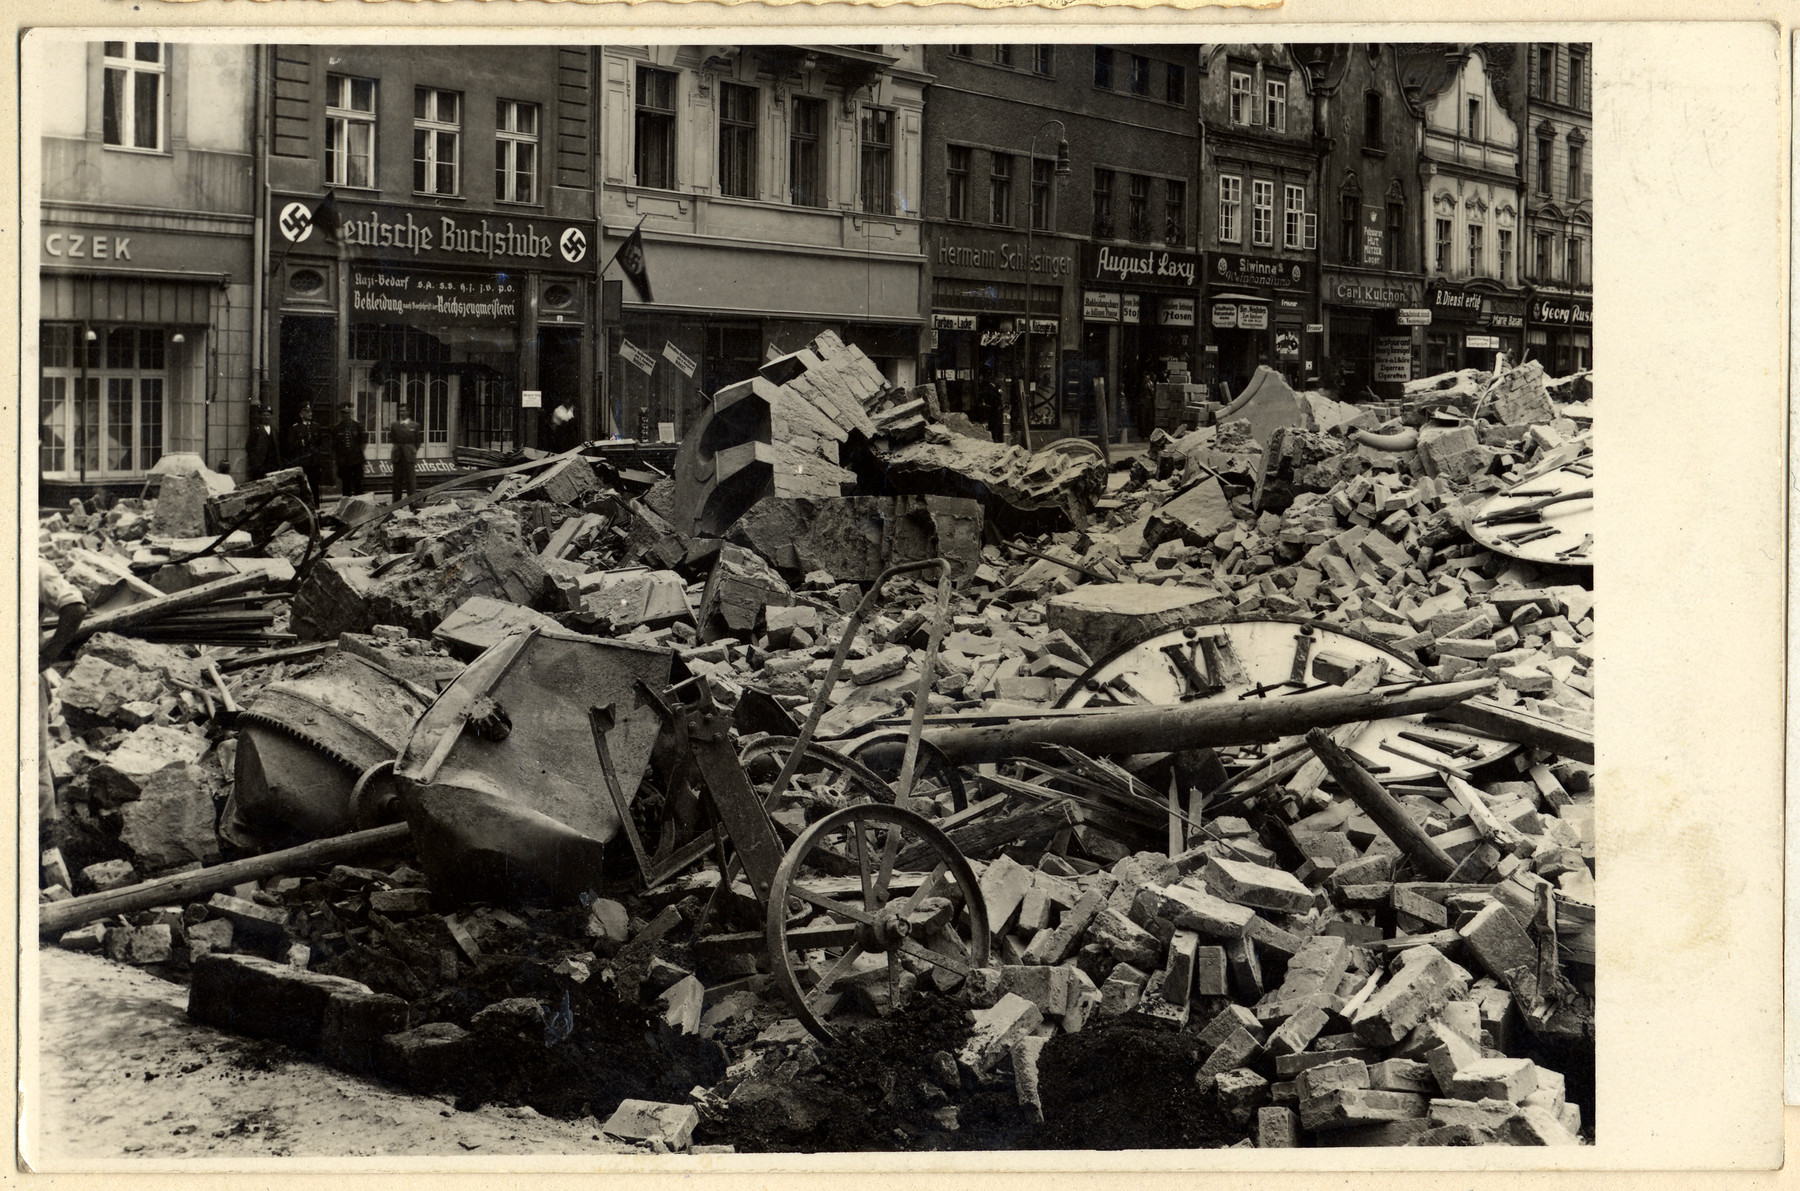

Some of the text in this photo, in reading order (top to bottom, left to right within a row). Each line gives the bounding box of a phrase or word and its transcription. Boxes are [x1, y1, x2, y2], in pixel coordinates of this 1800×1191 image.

[342, 210, 552, 260] eutsche Buchstube
[45, 233, 131, 260] CZEK
[938, 236, 996, 269] Hermann
[1096, 246, 1195, 286] August Laxy
[354, 272, 410, 290] Nazi-Bedarf
[1337, 284, 1361, 299] Carl
[354, 289, 404, 314] Bekleidung
[437, 294, 515, 319] Reichszeugmeisterei
[1541, 301, 1570, 323] Georg
[934, 315, 953, 328] Farben
[1163, 310, 1192, 323] Hosen
[1380, 364, 1404, 373] Zigarren
